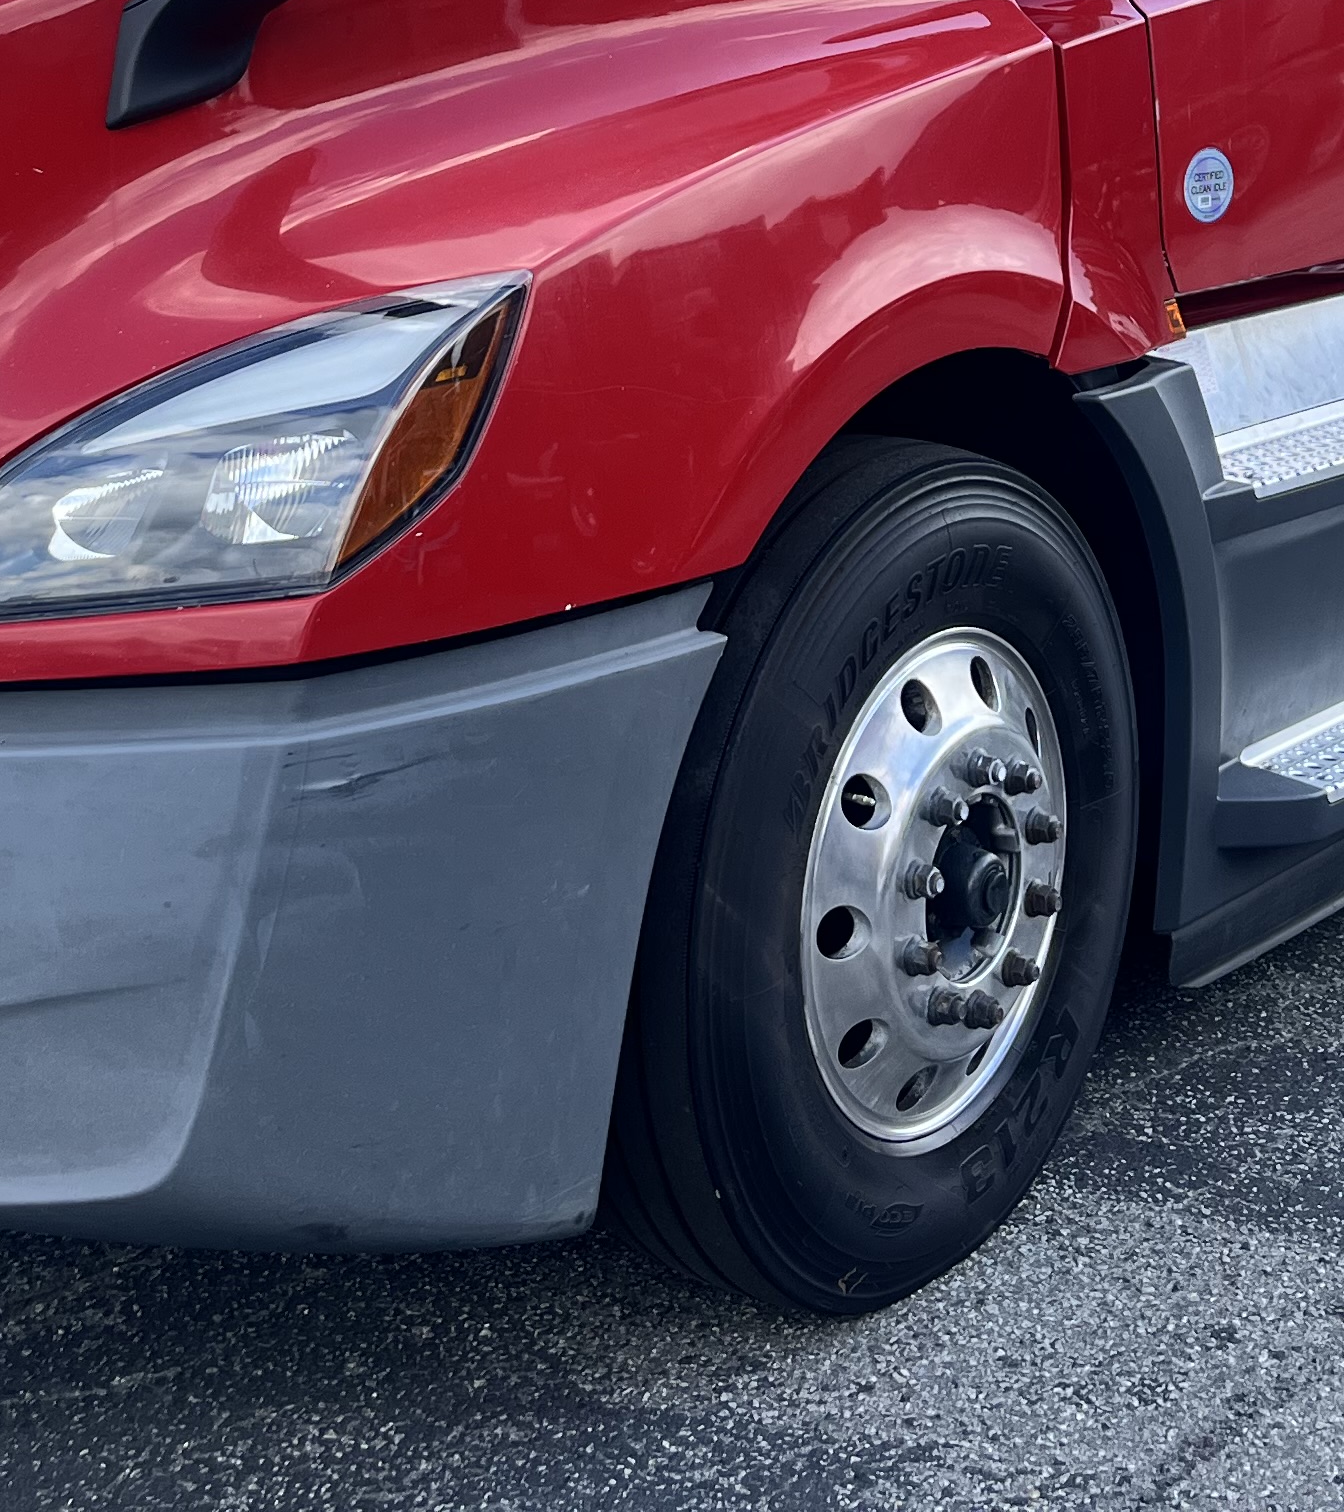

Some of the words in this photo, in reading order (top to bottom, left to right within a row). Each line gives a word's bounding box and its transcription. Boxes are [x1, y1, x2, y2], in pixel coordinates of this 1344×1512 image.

[1190, 184, 1212, 195] CLEAN
[1193, 170, 1224, 182] CERTIFIED
[782, 543, 1013, 843] BRIDGESTONE
[959, 1006, 1080, 1207] R213
